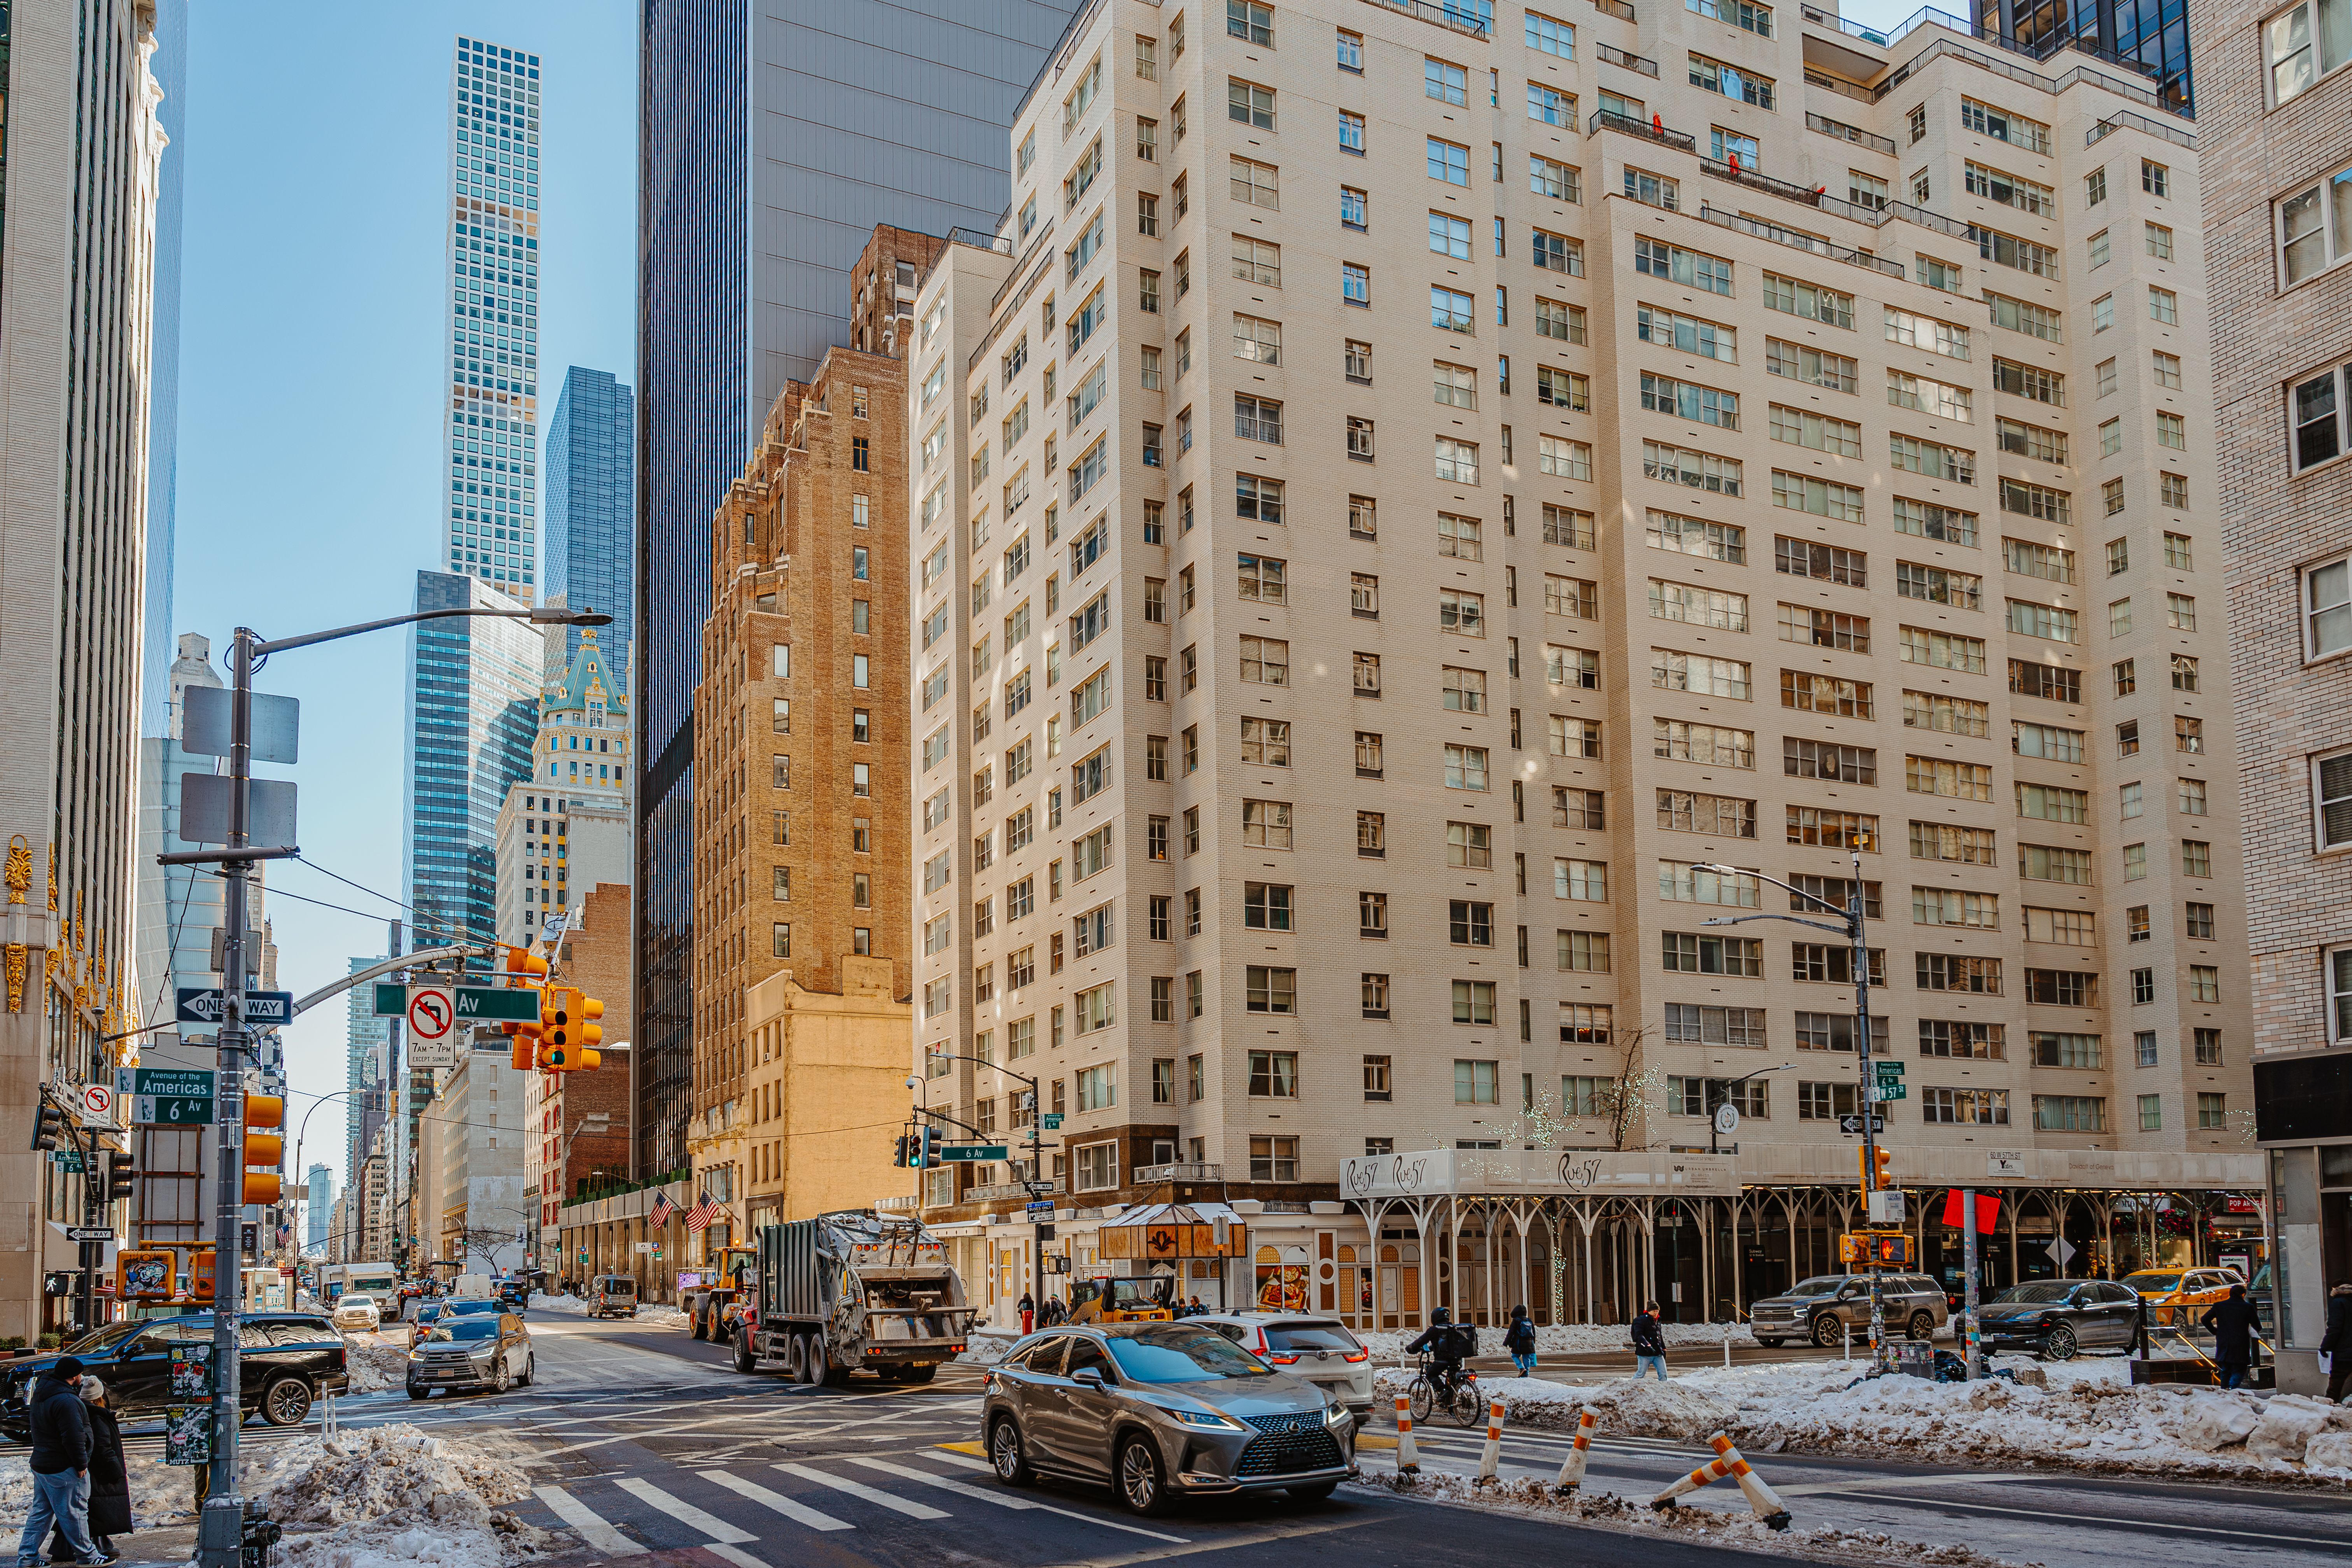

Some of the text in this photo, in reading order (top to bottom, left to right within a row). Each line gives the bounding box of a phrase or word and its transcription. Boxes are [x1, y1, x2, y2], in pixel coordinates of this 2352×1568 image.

[196, 999, 279, 1014] ONE WAY
[458, 993, 479, 1012] Av
[412, 1043, 427, 1052] 7AM
[436, 1043, 451, 1052] 7PM
[143, 1080, 207, 1094] Americas
[1882, 1078, 1886, 1087] 6
[1880, 1088, 1886, 1099] W
[1888, 1087, 1897, 1098] 57
[170, 1100, 201, 1120] 6 Av
[966, 1149, 983, 1157] 6 Av
[69, 1164, 74, 1172] 6
[2000, 1160, 2013, 1169] Yates
